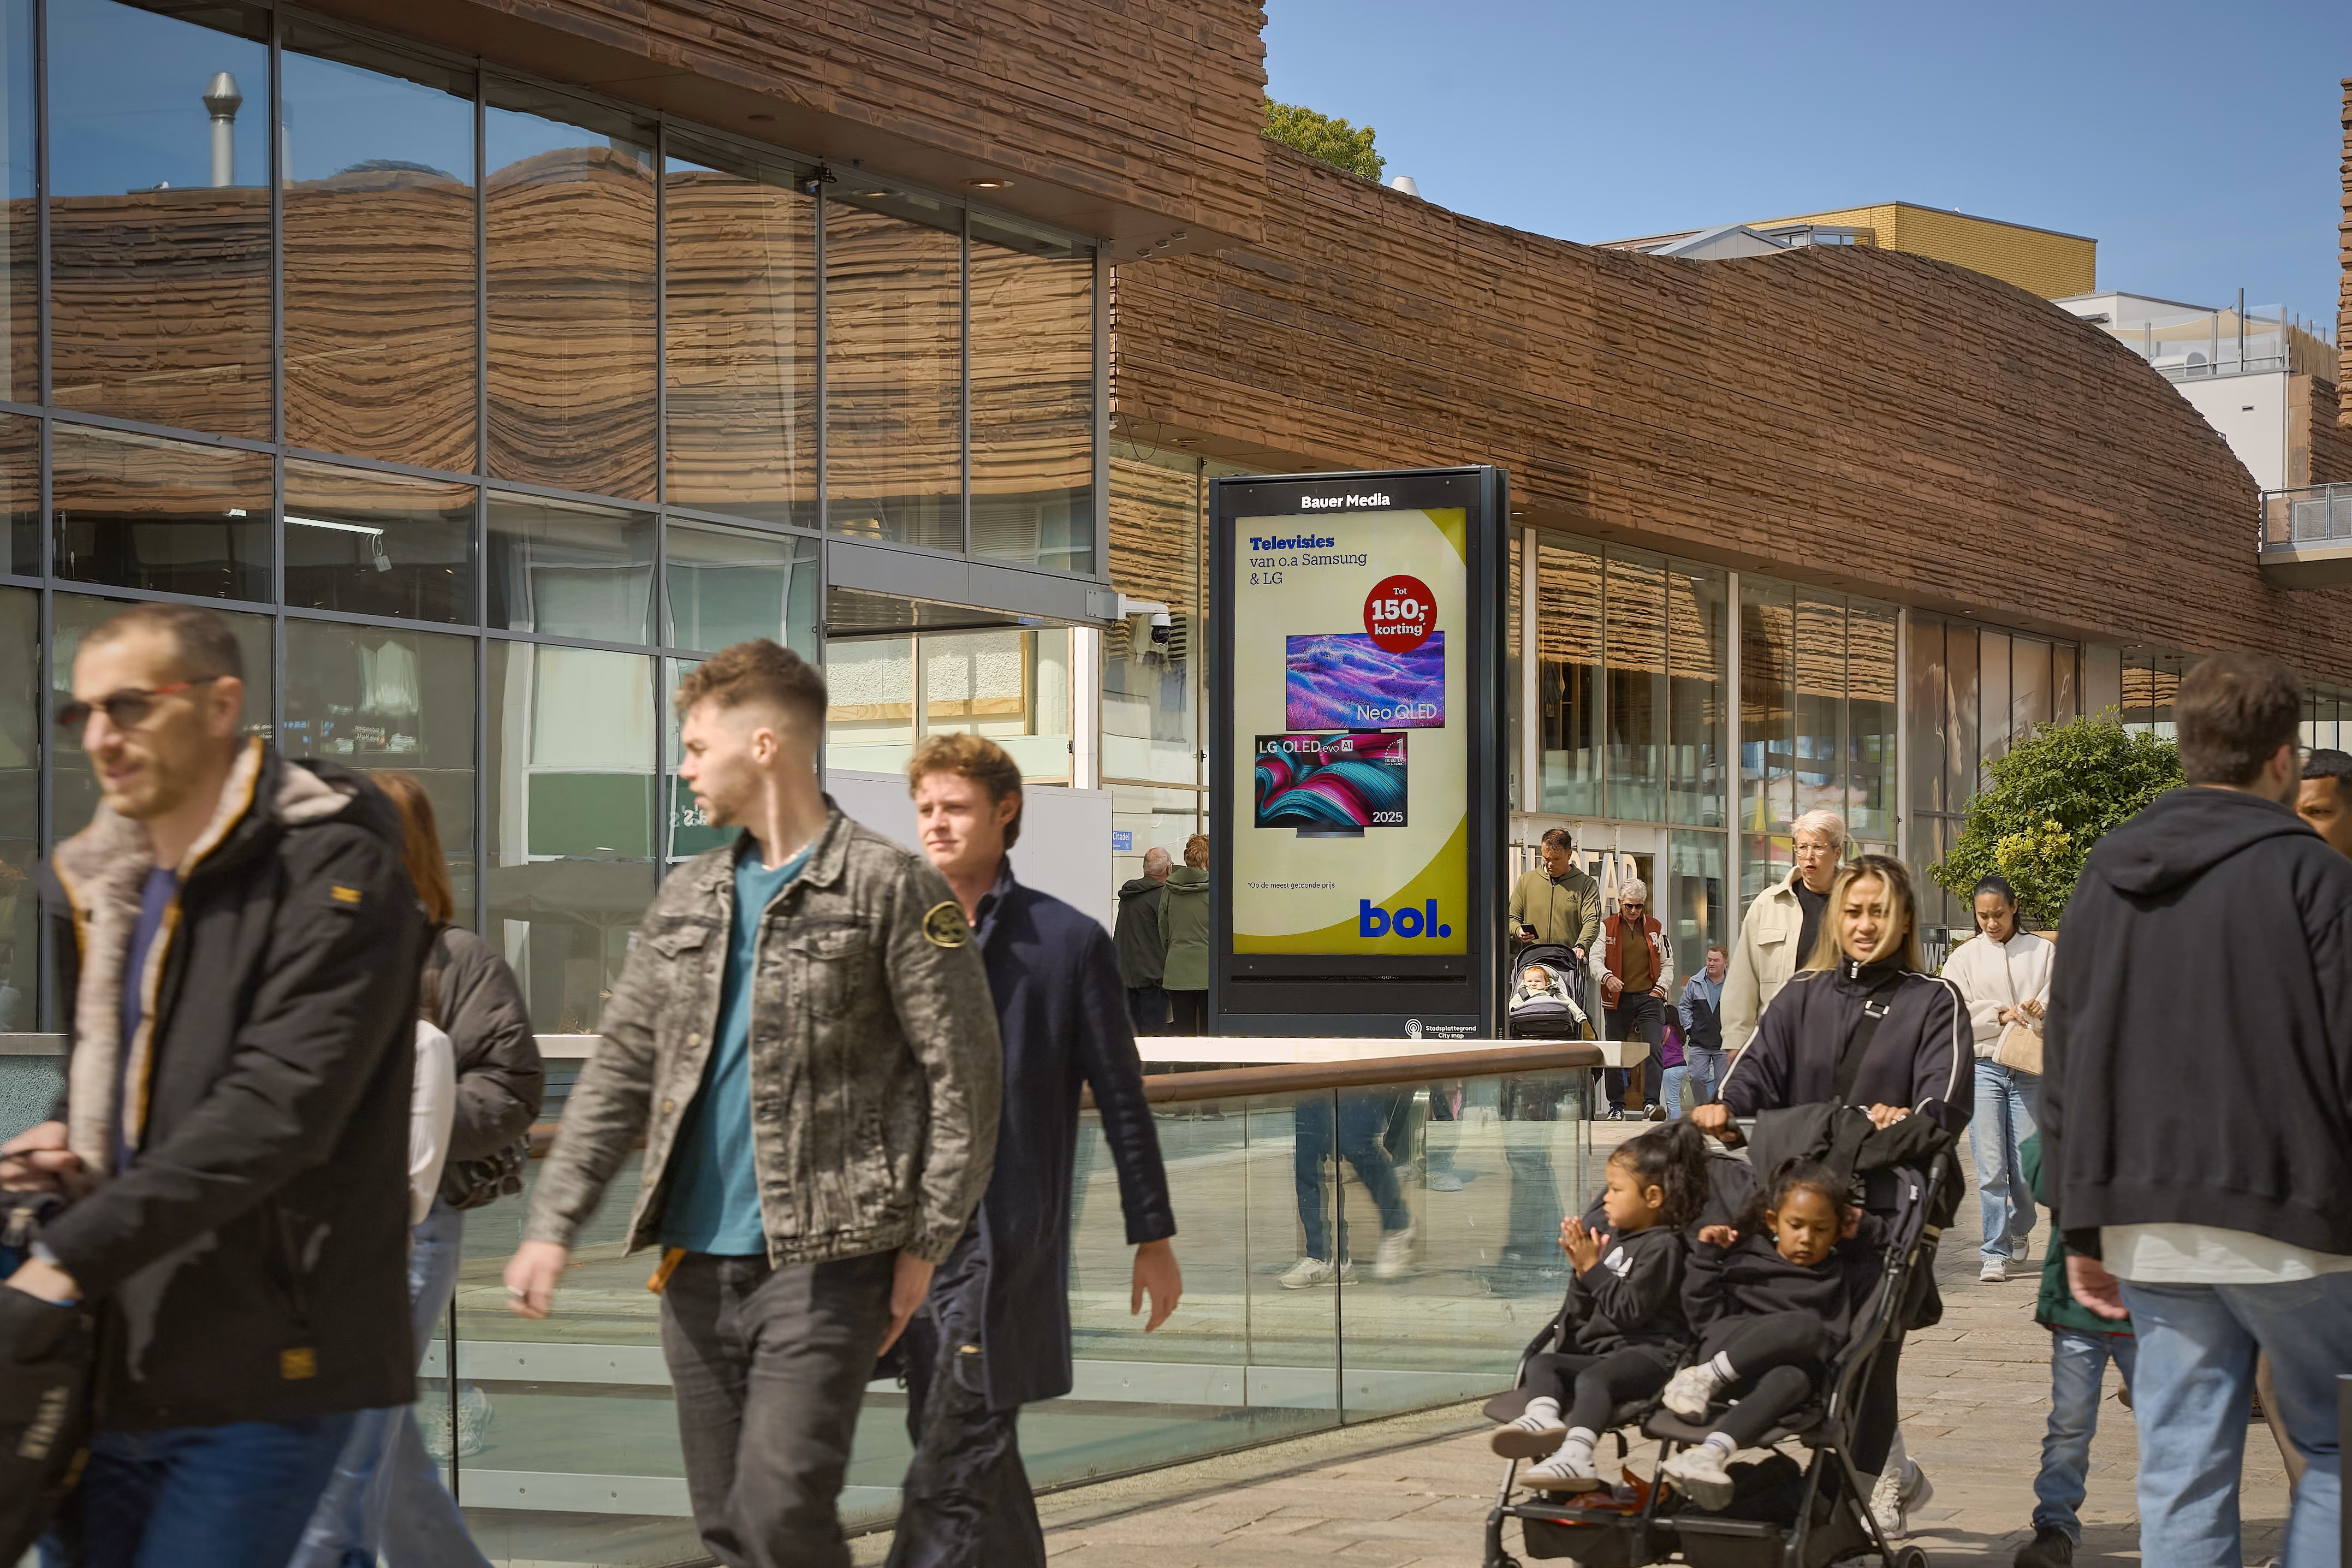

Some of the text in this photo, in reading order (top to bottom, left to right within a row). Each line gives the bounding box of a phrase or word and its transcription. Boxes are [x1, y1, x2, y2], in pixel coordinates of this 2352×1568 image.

[1301, 492, 1391, 509] Bauer Media
[1250, 534, 1335, 550] Televisies
[1250, 553, 1368, 567] van o.a Samsung
[1250, 572, 1282, 585] & LG
[1371, 598, 1429, 621] 150,-
[1357, 704, 1438, 720] Neo QLED
[1260, 741, 1278, 753] LG
[1282, 740, 1321, 753] OLED
[1342, 740, 1353, 750] AI
[1372, 811, 1403, 823] 2025
[1113, 831, 1130, 841] Citadel
[1359, 899, 1452, 939] bol.
